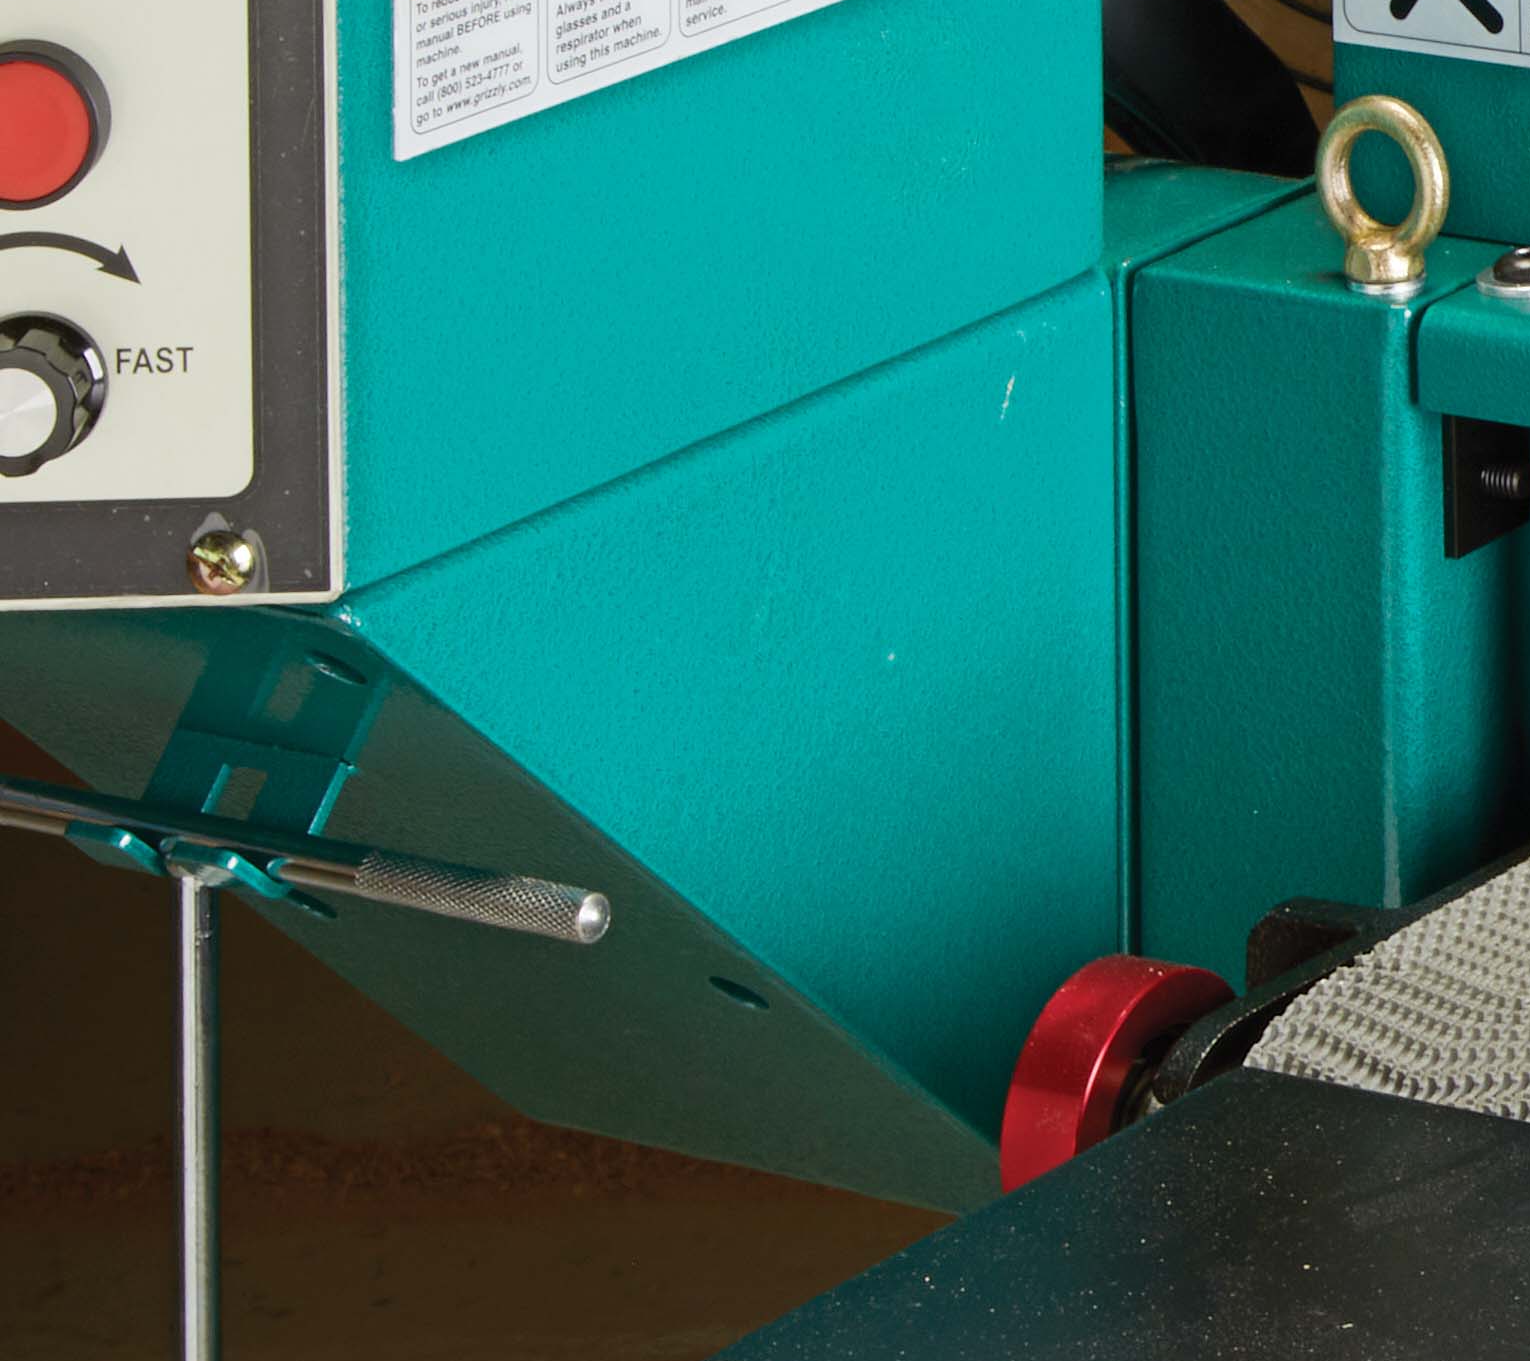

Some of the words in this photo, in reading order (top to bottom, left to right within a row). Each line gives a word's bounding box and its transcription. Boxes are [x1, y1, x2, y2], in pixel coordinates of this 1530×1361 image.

[555, 12, 598, 40] glasses
[600, 1, 622, 20] and
[624, 1, 631, 12] a
[556, 26, 610, 54] respirator
[612, 15, 642, 34] when
[685, 4, 727, 28] service.
[556, 53, 587, 73] using
[589, 44, 610, 61] this
[613, 27, 661, 52] machine.
[115, 346, 193, 374] FAST
